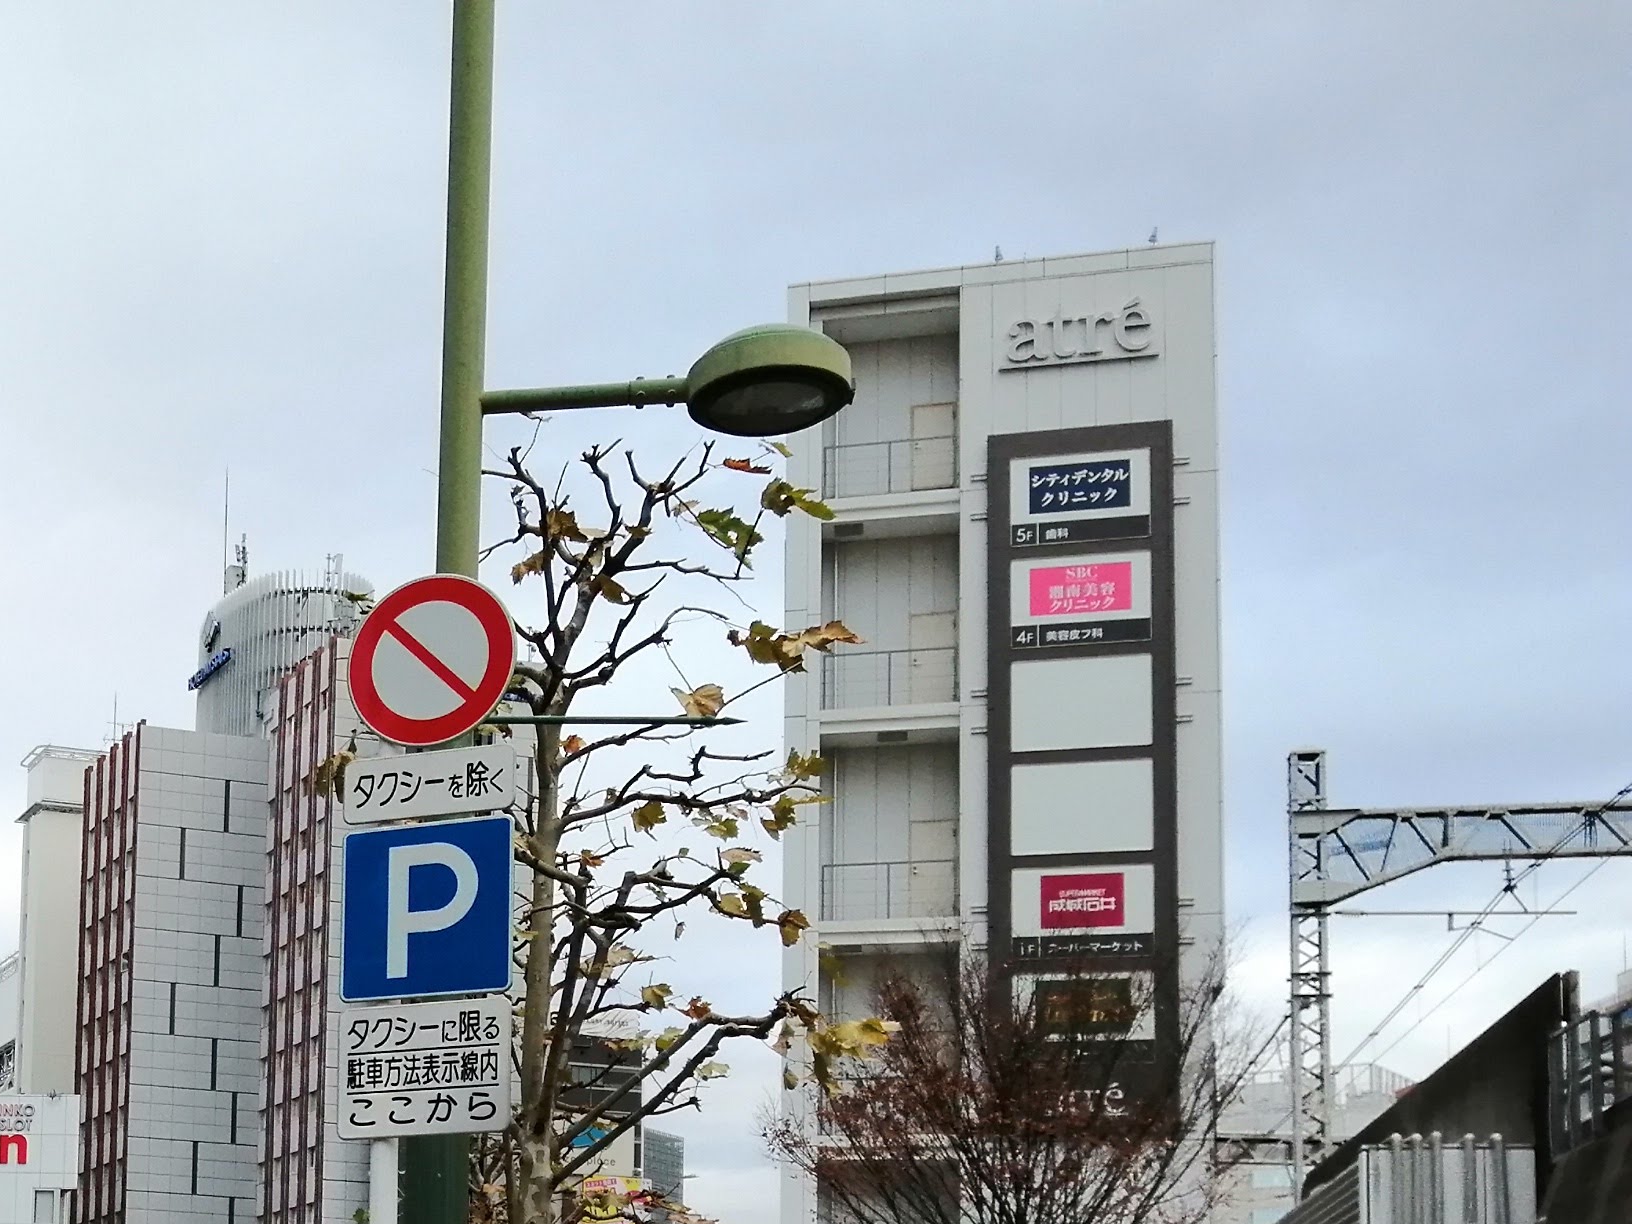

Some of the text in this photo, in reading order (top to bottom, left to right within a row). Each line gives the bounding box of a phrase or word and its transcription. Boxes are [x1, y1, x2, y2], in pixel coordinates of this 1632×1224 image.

[1007, 296, 1152, 363] atré
[1031, 468, 1129, 488] シティデンタル
[1041, 487, 1118, 507] クリニック
[1016, 528, 1034, 542] 5F
[1045, 527, 1069, 540] 歯科
[1065, 566, 1099, 579] SBC
[1049, 596, 1116, 614] クリニック
[1016, 630, 1034, 644] 4F
[1046, 627, 1104, 642] 美容皮フ科
[353, 760, 505, 809] タクシーを除く
[386, 842, 480, 980] P
[348, 1010, 500, 1049] タクシーに限る
[347, 1049, 499, 1089] 駐車方法表示線内
[349, 1093, 497, 1126] ここから
